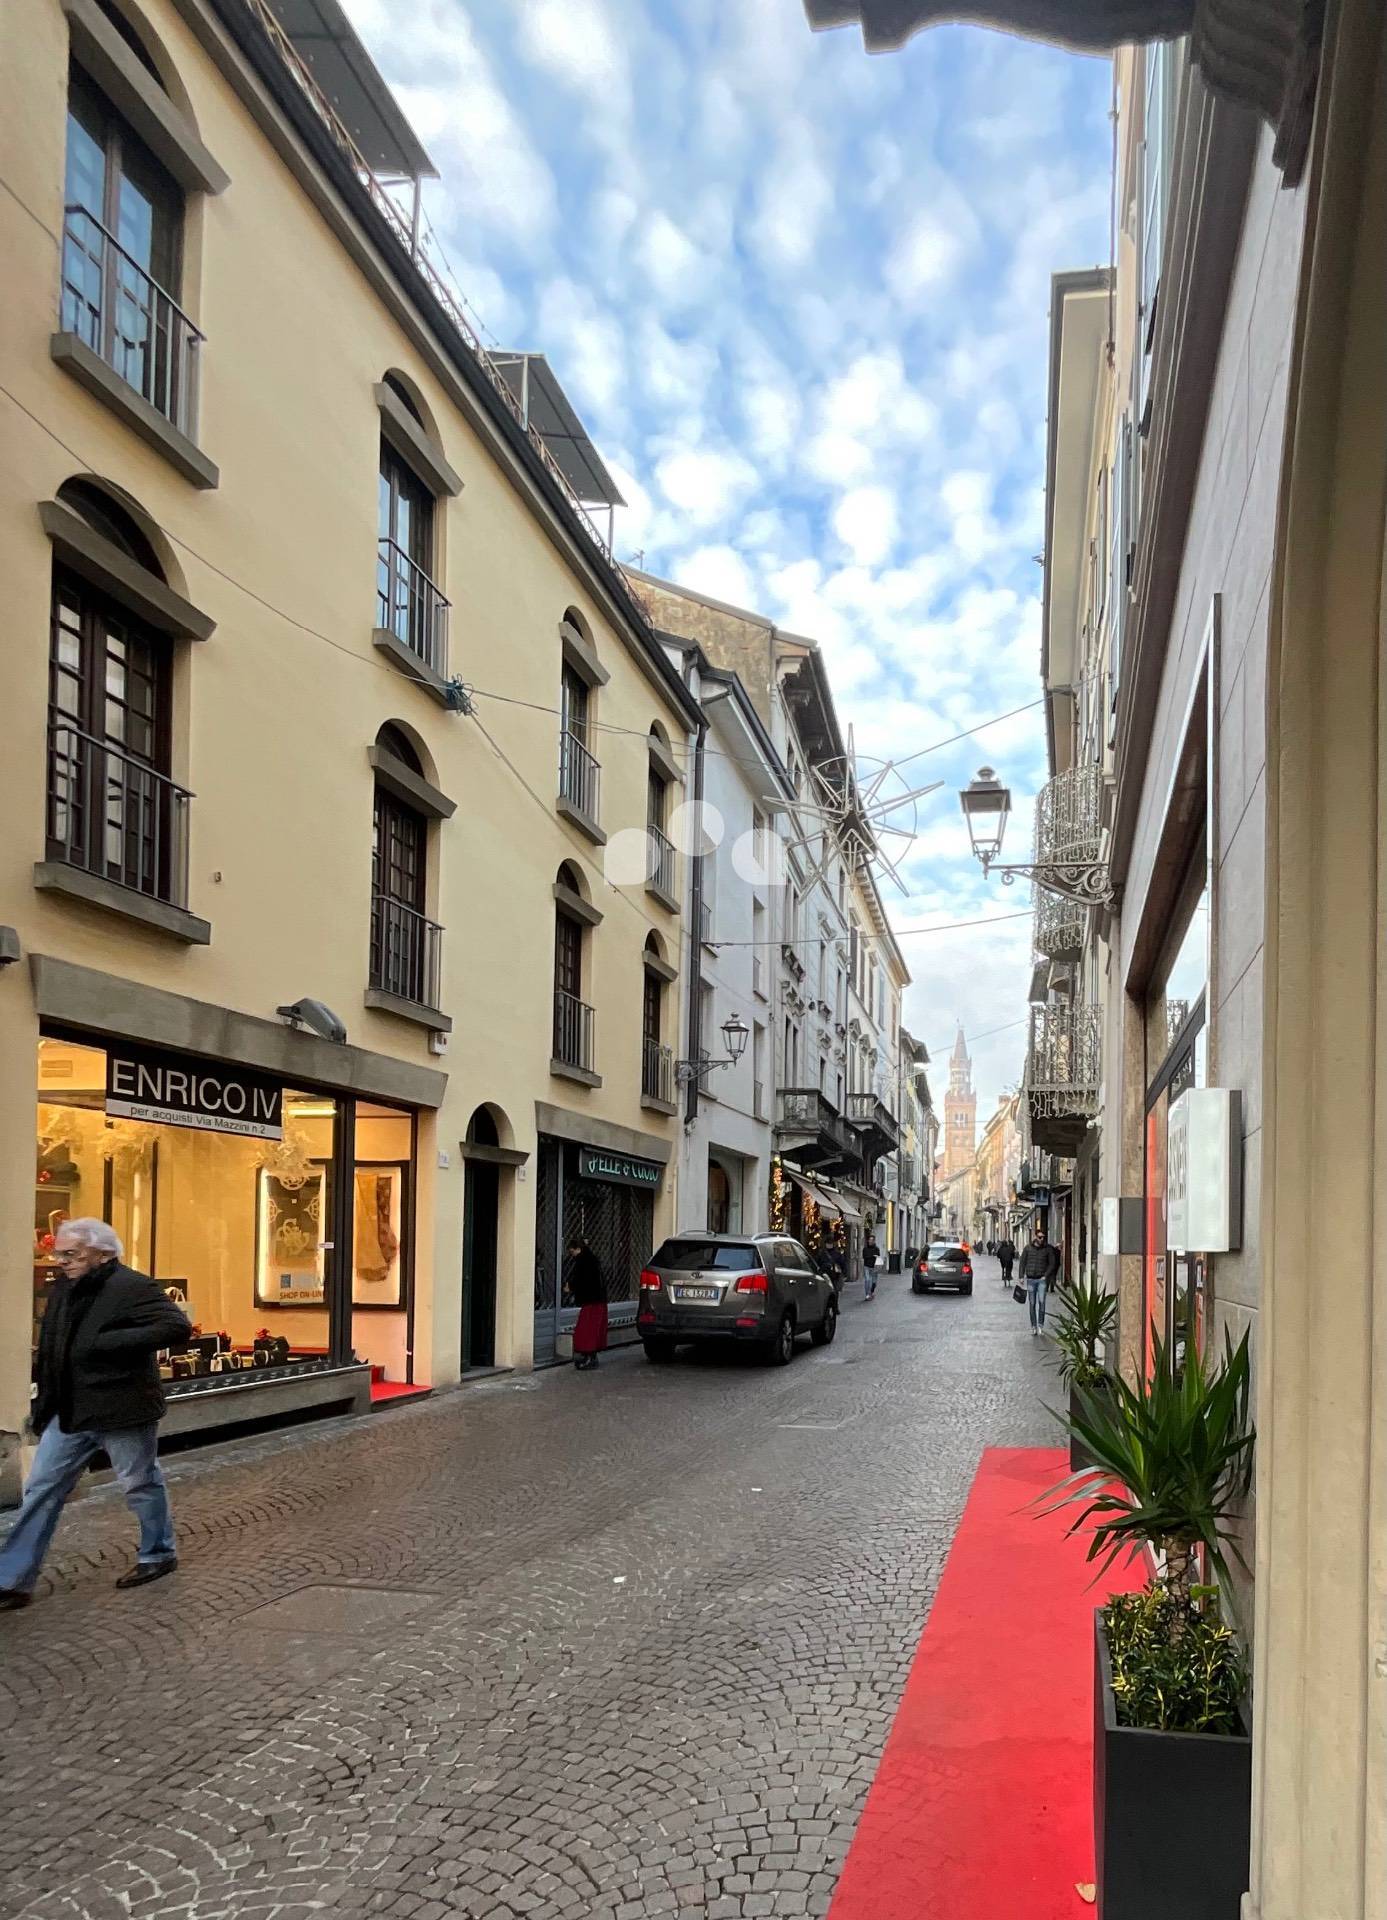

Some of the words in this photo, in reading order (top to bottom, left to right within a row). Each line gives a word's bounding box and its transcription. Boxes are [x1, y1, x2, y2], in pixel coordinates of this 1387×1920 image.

[113, 1059, 246, 1114] ENRICO
[253, 1088, 278, 1119] IV
[130, 1106, 149, 1118] per
[153, 1110, 193, 1124] acquisti
[196, 1115, 212, 1126] Via
[214, 1118, 250, 1132] Mazzini
[280, 1291, 299, 1299] SHOP
[300, 1289, 327, 1298] ON-LIN
